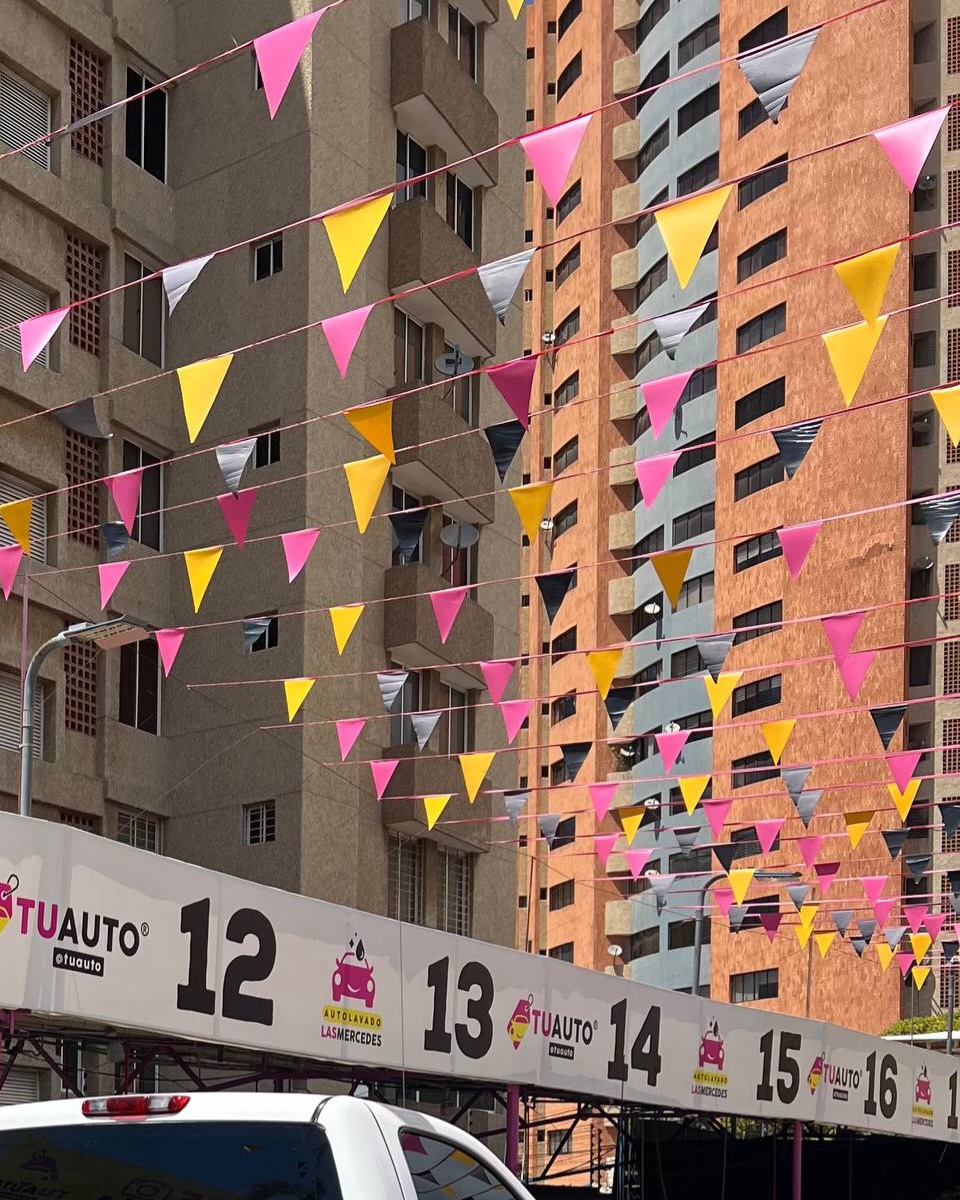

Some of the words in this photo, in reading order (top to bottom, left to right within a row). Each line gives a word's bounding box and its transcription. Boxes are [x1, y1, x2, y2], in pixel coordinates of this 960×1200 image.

[55, 953, 102, 972] @tuauto
[176, 897, 277, 1026] 12
[324, 1009, 382, 1027] AUTOLAVADO
[424, 956, 495, 1060] 13
[607, 998, 662, 1087] 14
[756, 1029, 802, 1104] 15
[863, 1050, 898, 1119] 16
